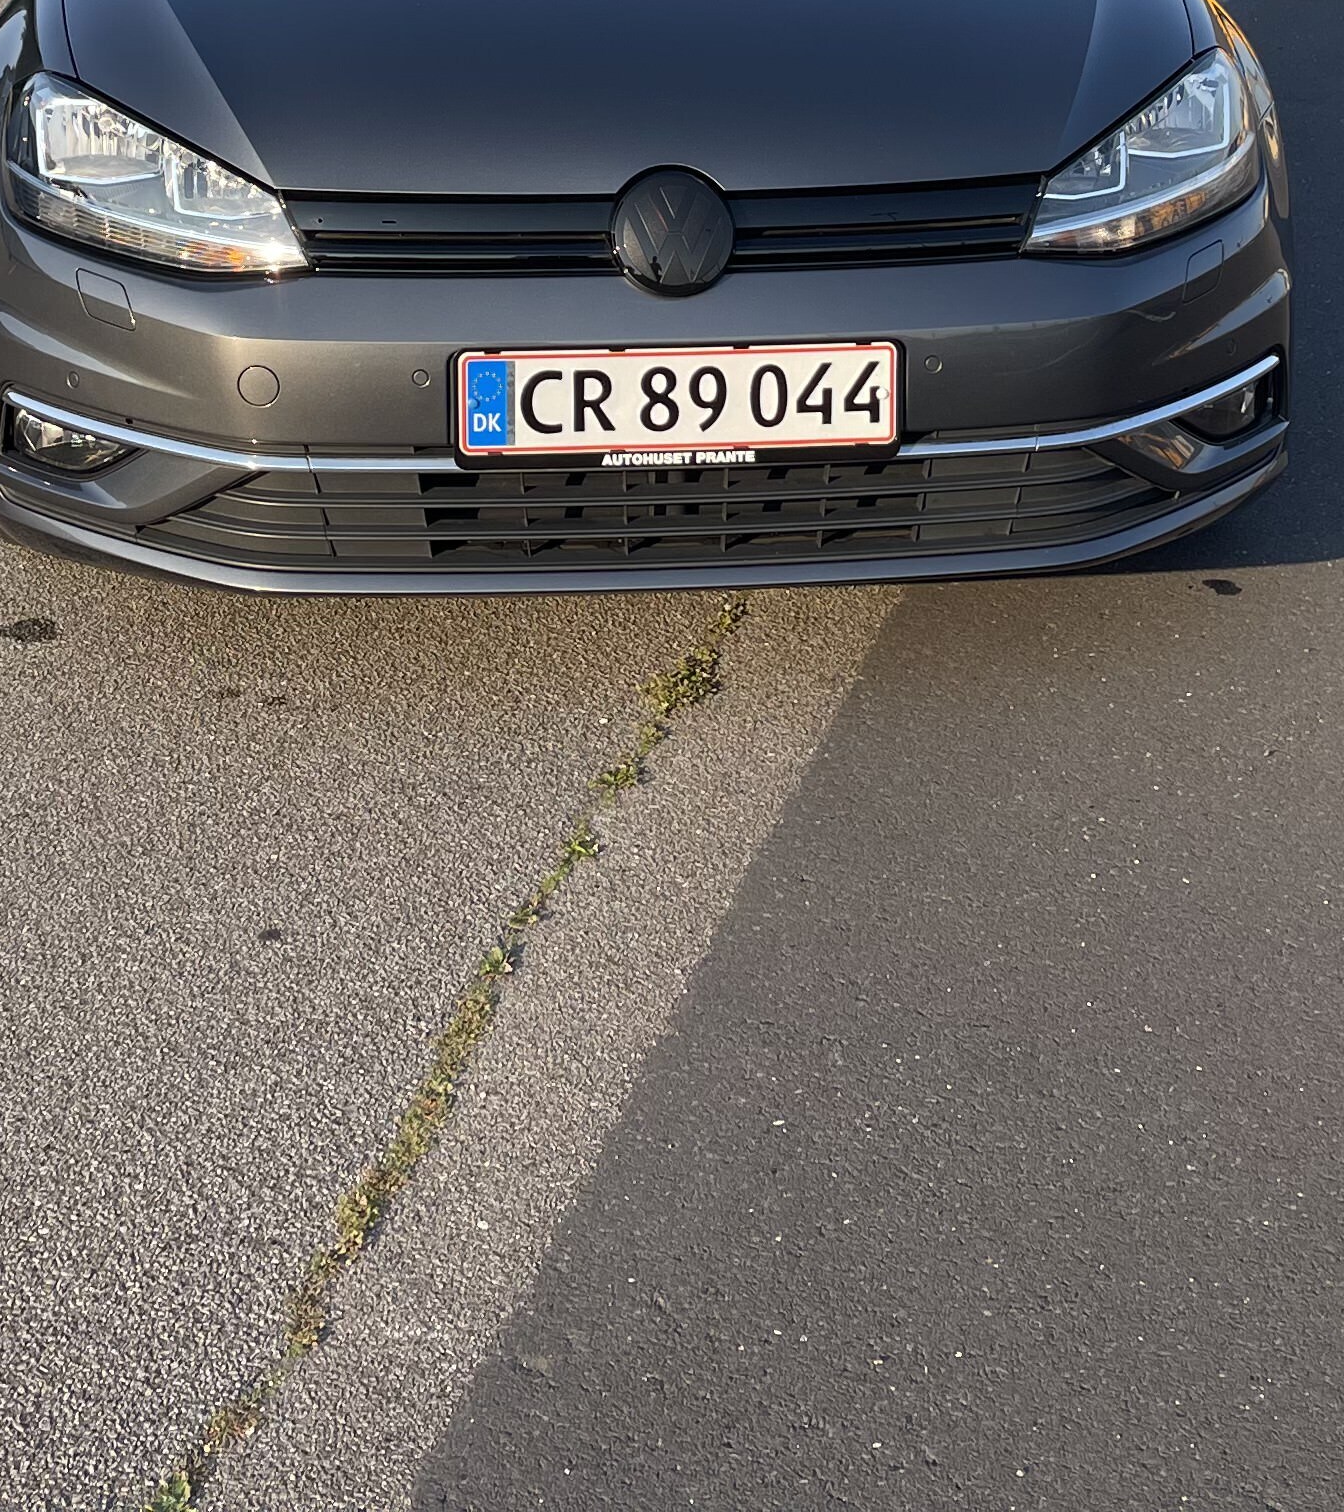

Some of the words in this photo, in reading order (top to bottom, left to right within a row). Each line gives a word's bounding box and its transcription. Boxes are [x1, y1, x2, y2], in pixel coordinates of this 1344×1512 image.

[520, 369, 616, 434] CR
[639, 365, 728, 433] 89
[750, 361, 880, 428] 044
[473, 413, 502, 433] DK
[601, 451, 693, 467] AUTOHUSET
[695, 450, 756, 465] PRANTE
